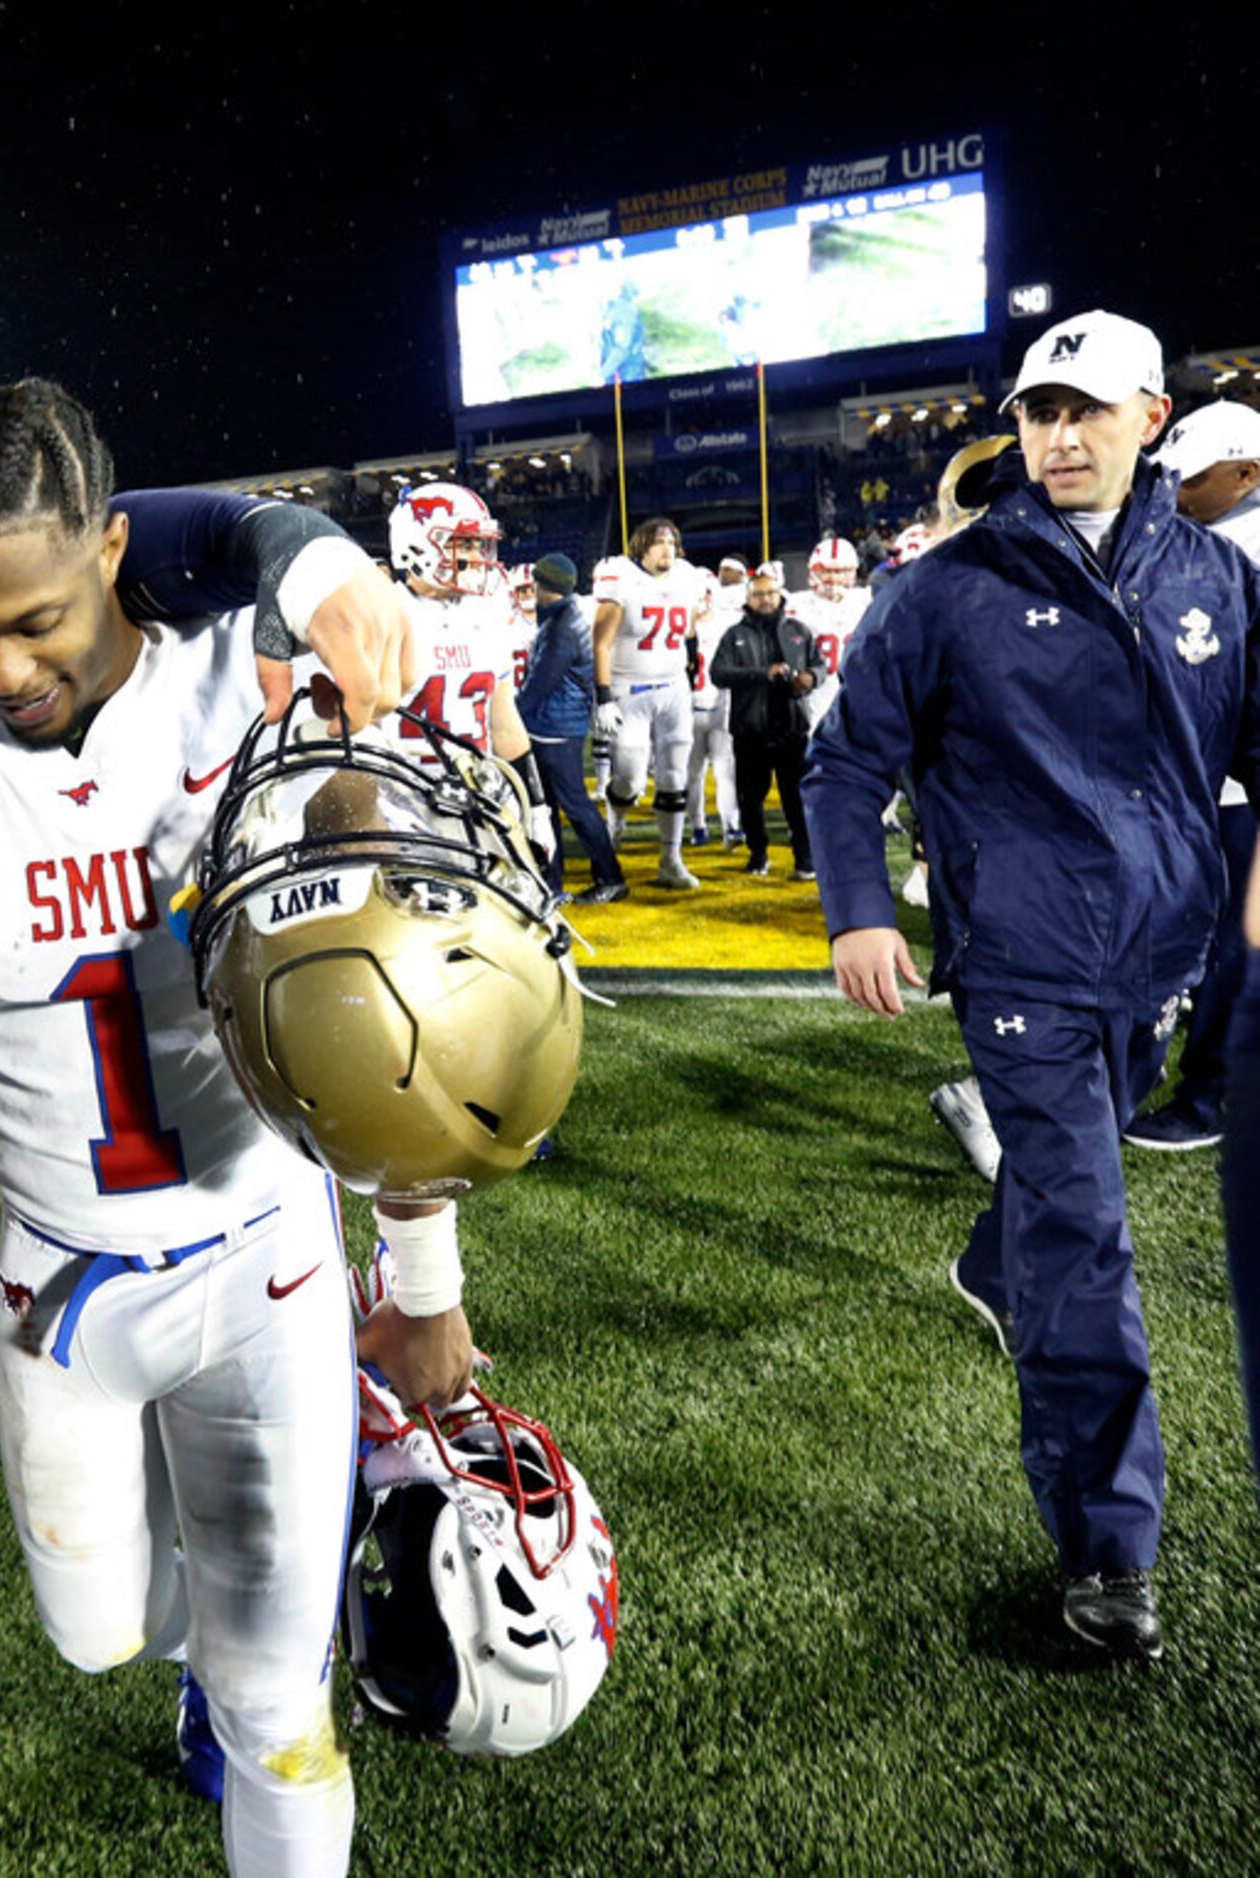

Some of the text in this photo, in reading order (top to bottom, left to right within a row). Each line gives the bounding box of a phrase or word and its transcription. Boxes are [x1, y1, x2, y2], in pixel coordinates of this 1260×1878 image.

[805, 164, 854, 182] Navy
[901, 134, 984, 178] UHG
[819, 168, 888, 195] Mutual
[1049, 332, 1087, 357] N
[699, 432, 747, 447] Allstate
[637, 607, 687, 650] 78
[434, 645, 471, 669] SMU
[25, 846, 159, 943] SMU
[269, 877, 342, 923] NAVY
[49, 950, 188, 1195] 1
